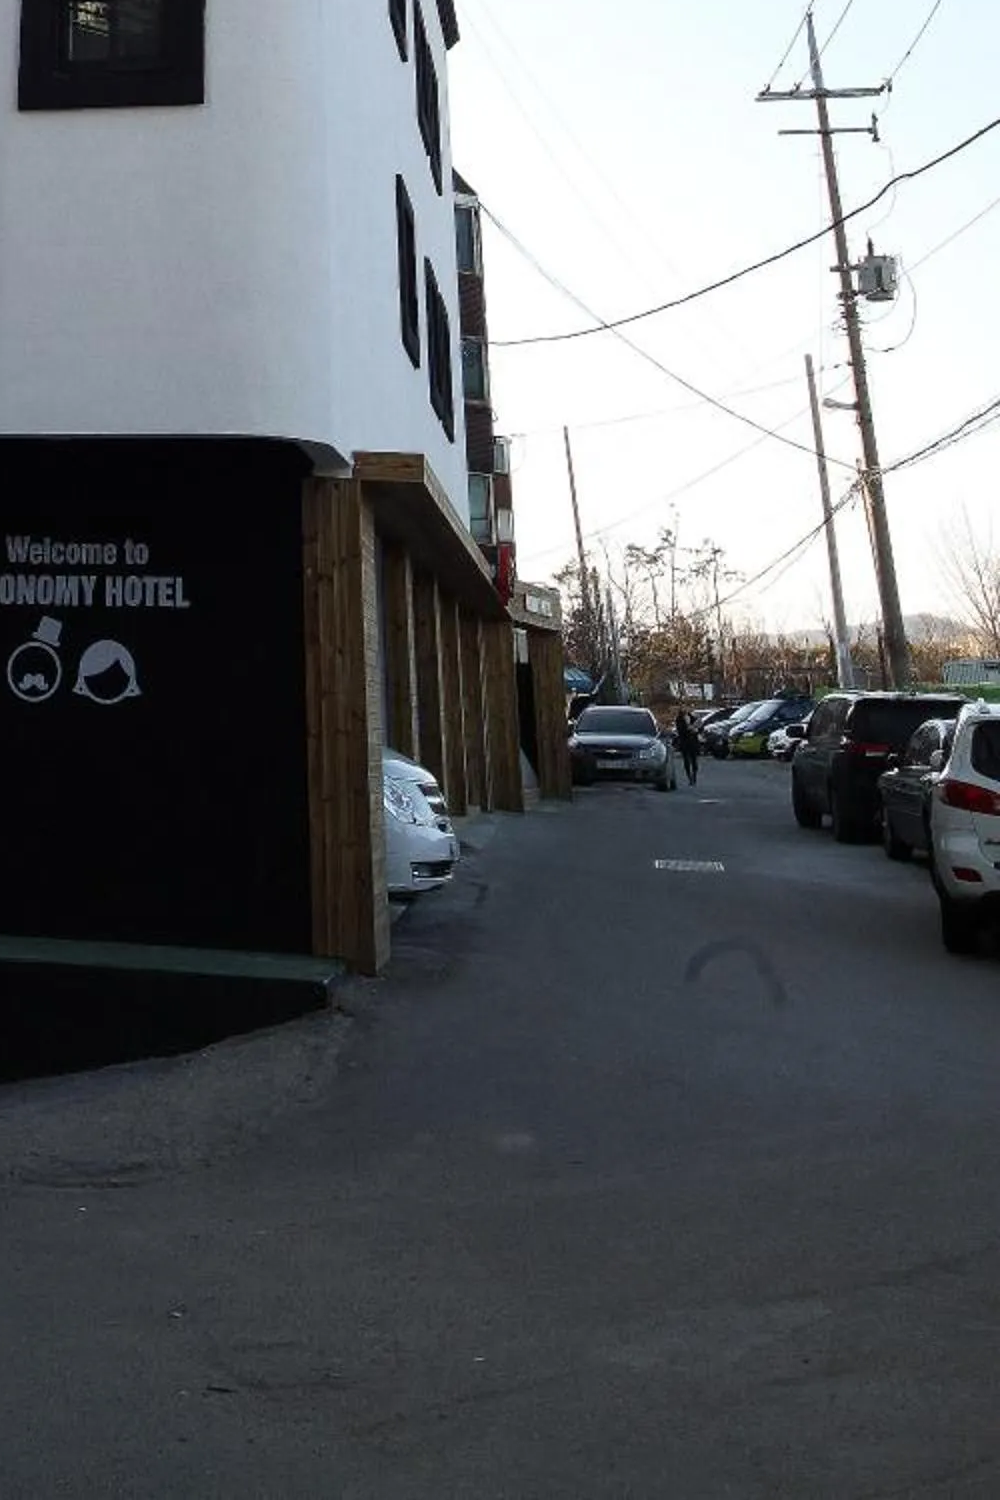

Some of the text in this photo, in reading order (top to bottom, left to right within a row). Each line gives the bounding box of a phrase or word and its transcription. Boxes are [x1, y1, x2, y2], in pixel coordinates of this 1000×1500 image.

[5, 534, 150, 566] Welcome to
[105, 575, 192, 609] HOTEL
